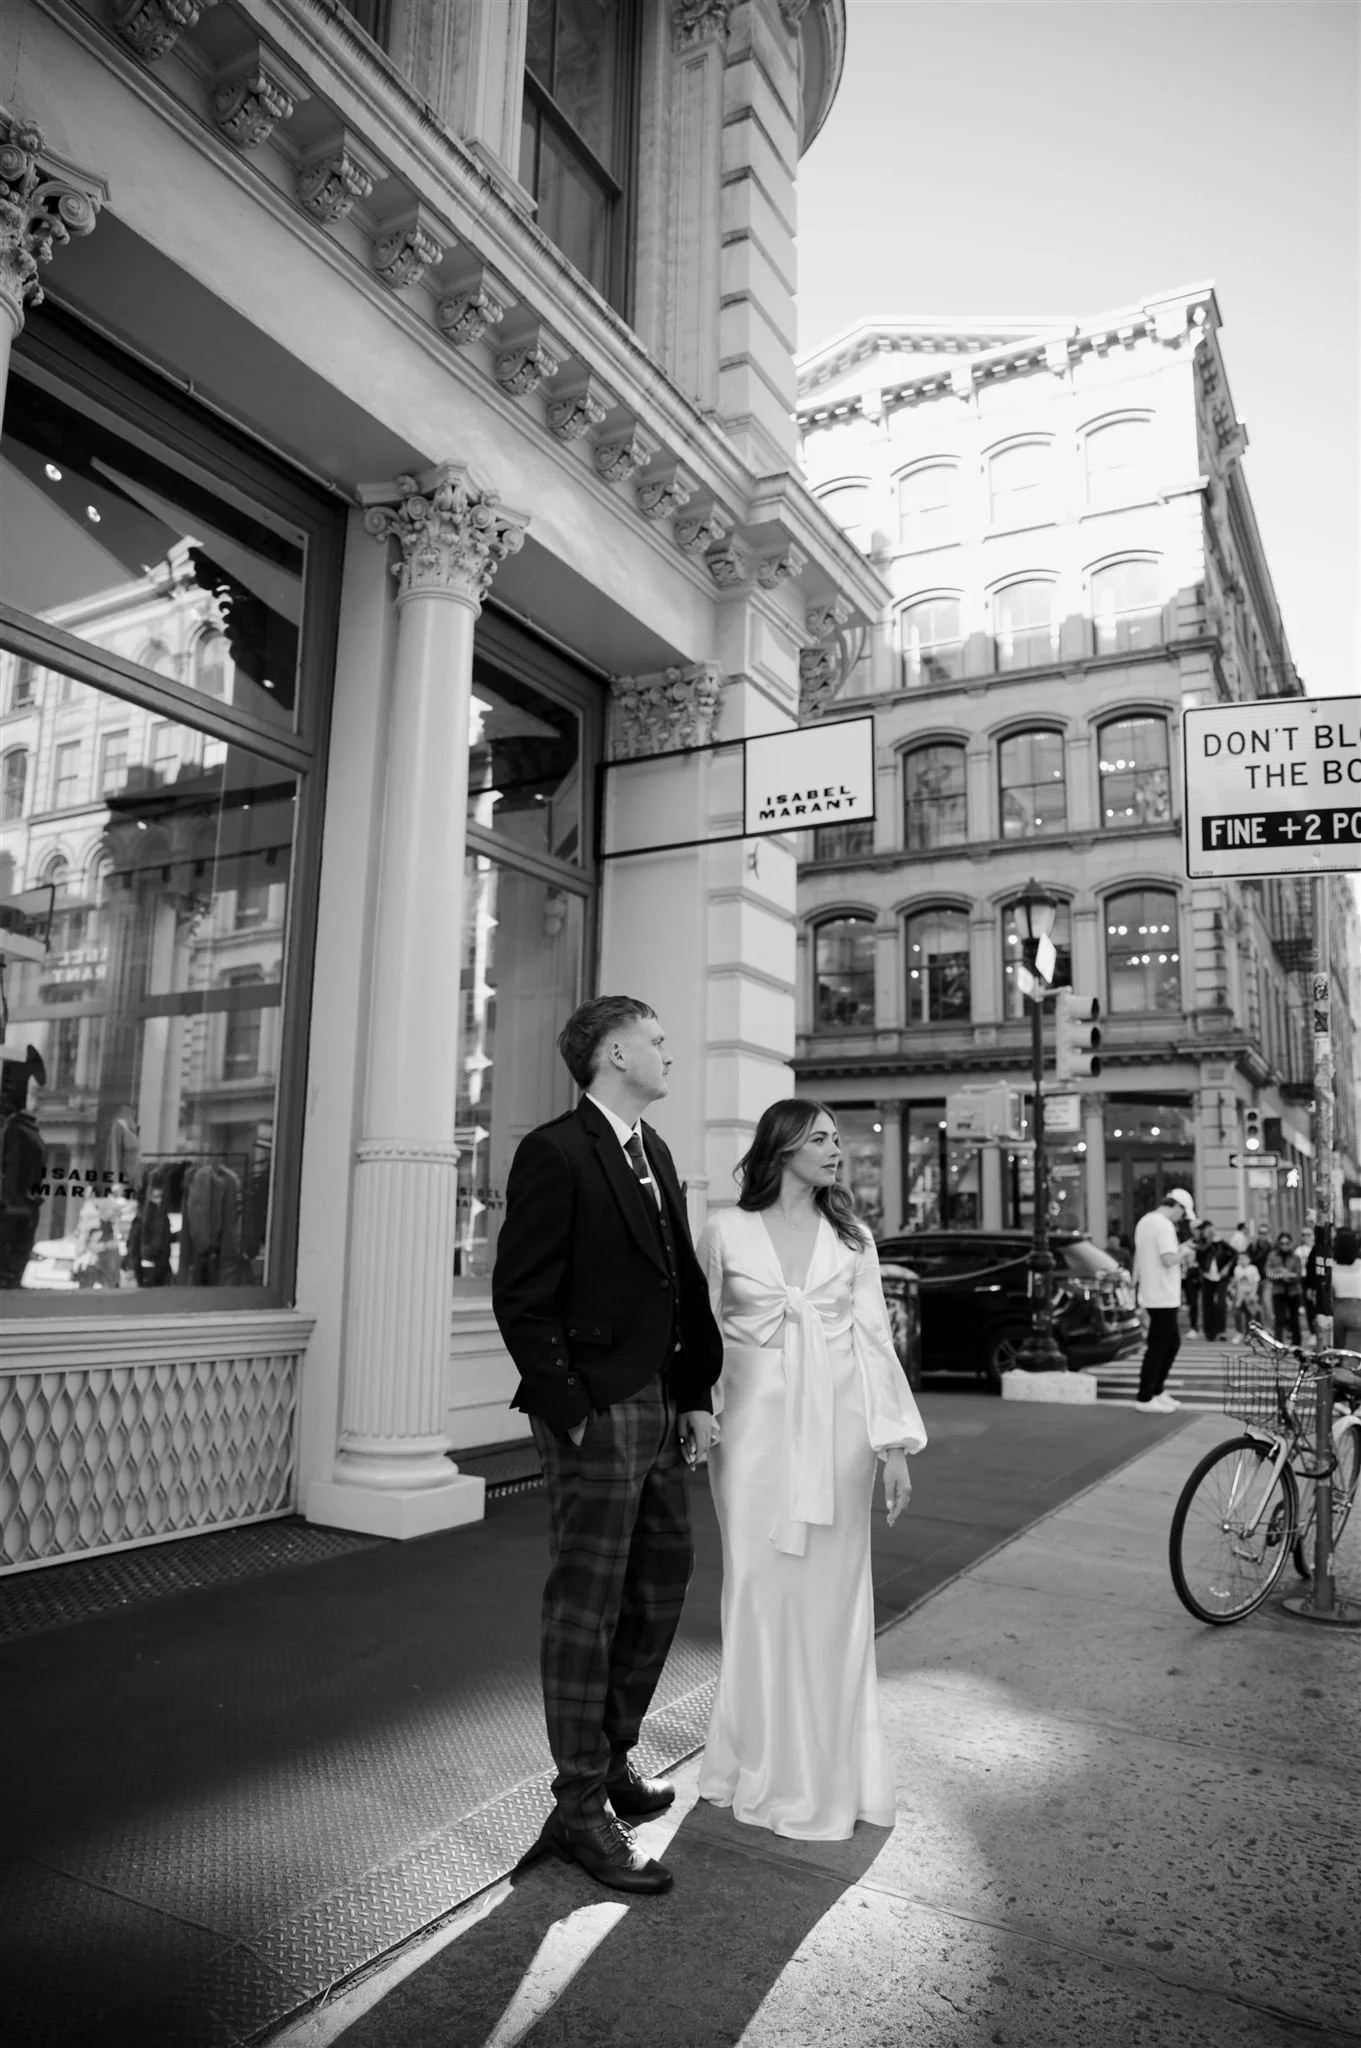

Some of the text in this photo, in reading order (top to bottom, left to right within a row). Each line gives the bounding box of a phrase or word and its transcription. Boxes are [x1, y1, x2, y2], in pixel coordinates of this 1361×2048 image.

[1204, 723, 1361, 757] DON'T BL
[1245, 762, 1308, 789] THE
[759, 796, 857, 820] MARANT
[766, 785, 851, 806] ISABEL
[1210, 817, 1267, 847] FINE
[1278, 813, 1322, 841] +2
[41, 1167, 129, 1184] ISABEL
